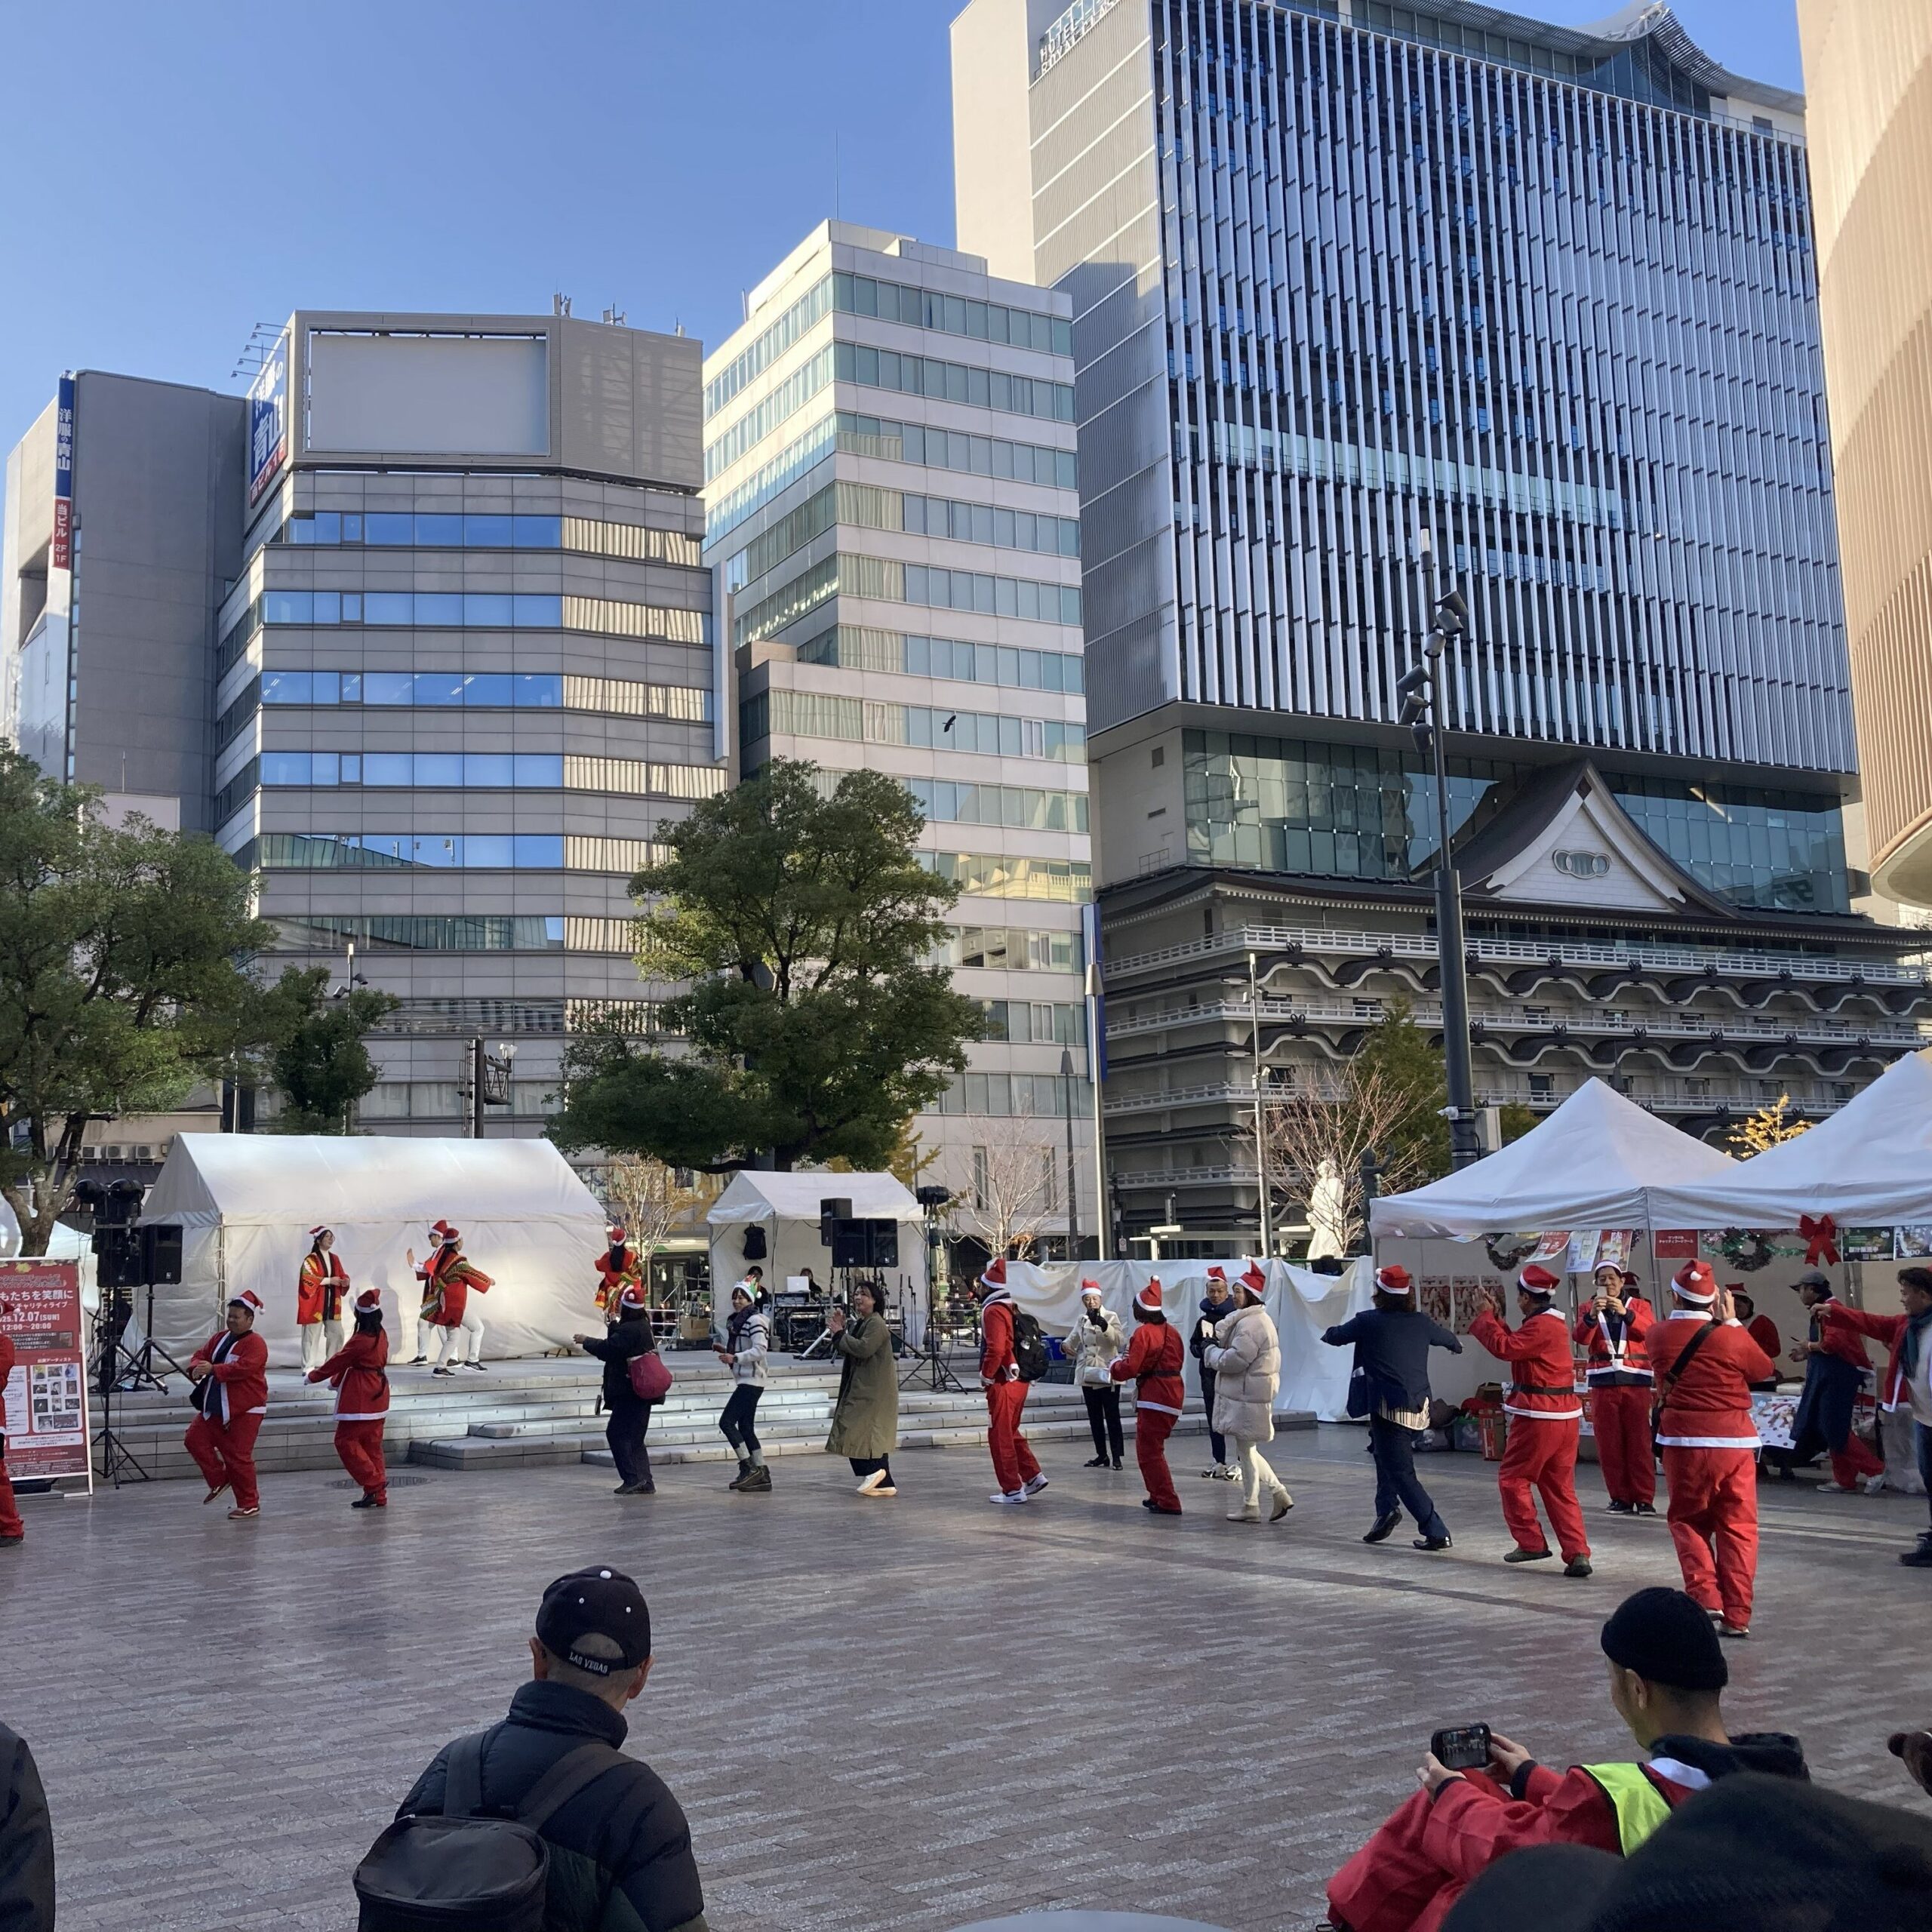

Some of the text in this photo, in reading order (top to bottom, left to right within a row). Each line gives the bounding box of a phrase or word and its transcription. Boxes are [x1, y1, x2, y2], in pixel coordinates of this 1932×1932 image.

[57, 408, 72, 472] 洋服の青山
[253, 394, 284, 475] 青山
[56, 503, 68, 539] 当ビル
[55, 543, 68, 552] 2F
[56, 554, 67, 564] 1F
[568, 1652, 608, 1674] LAS VEGAS
